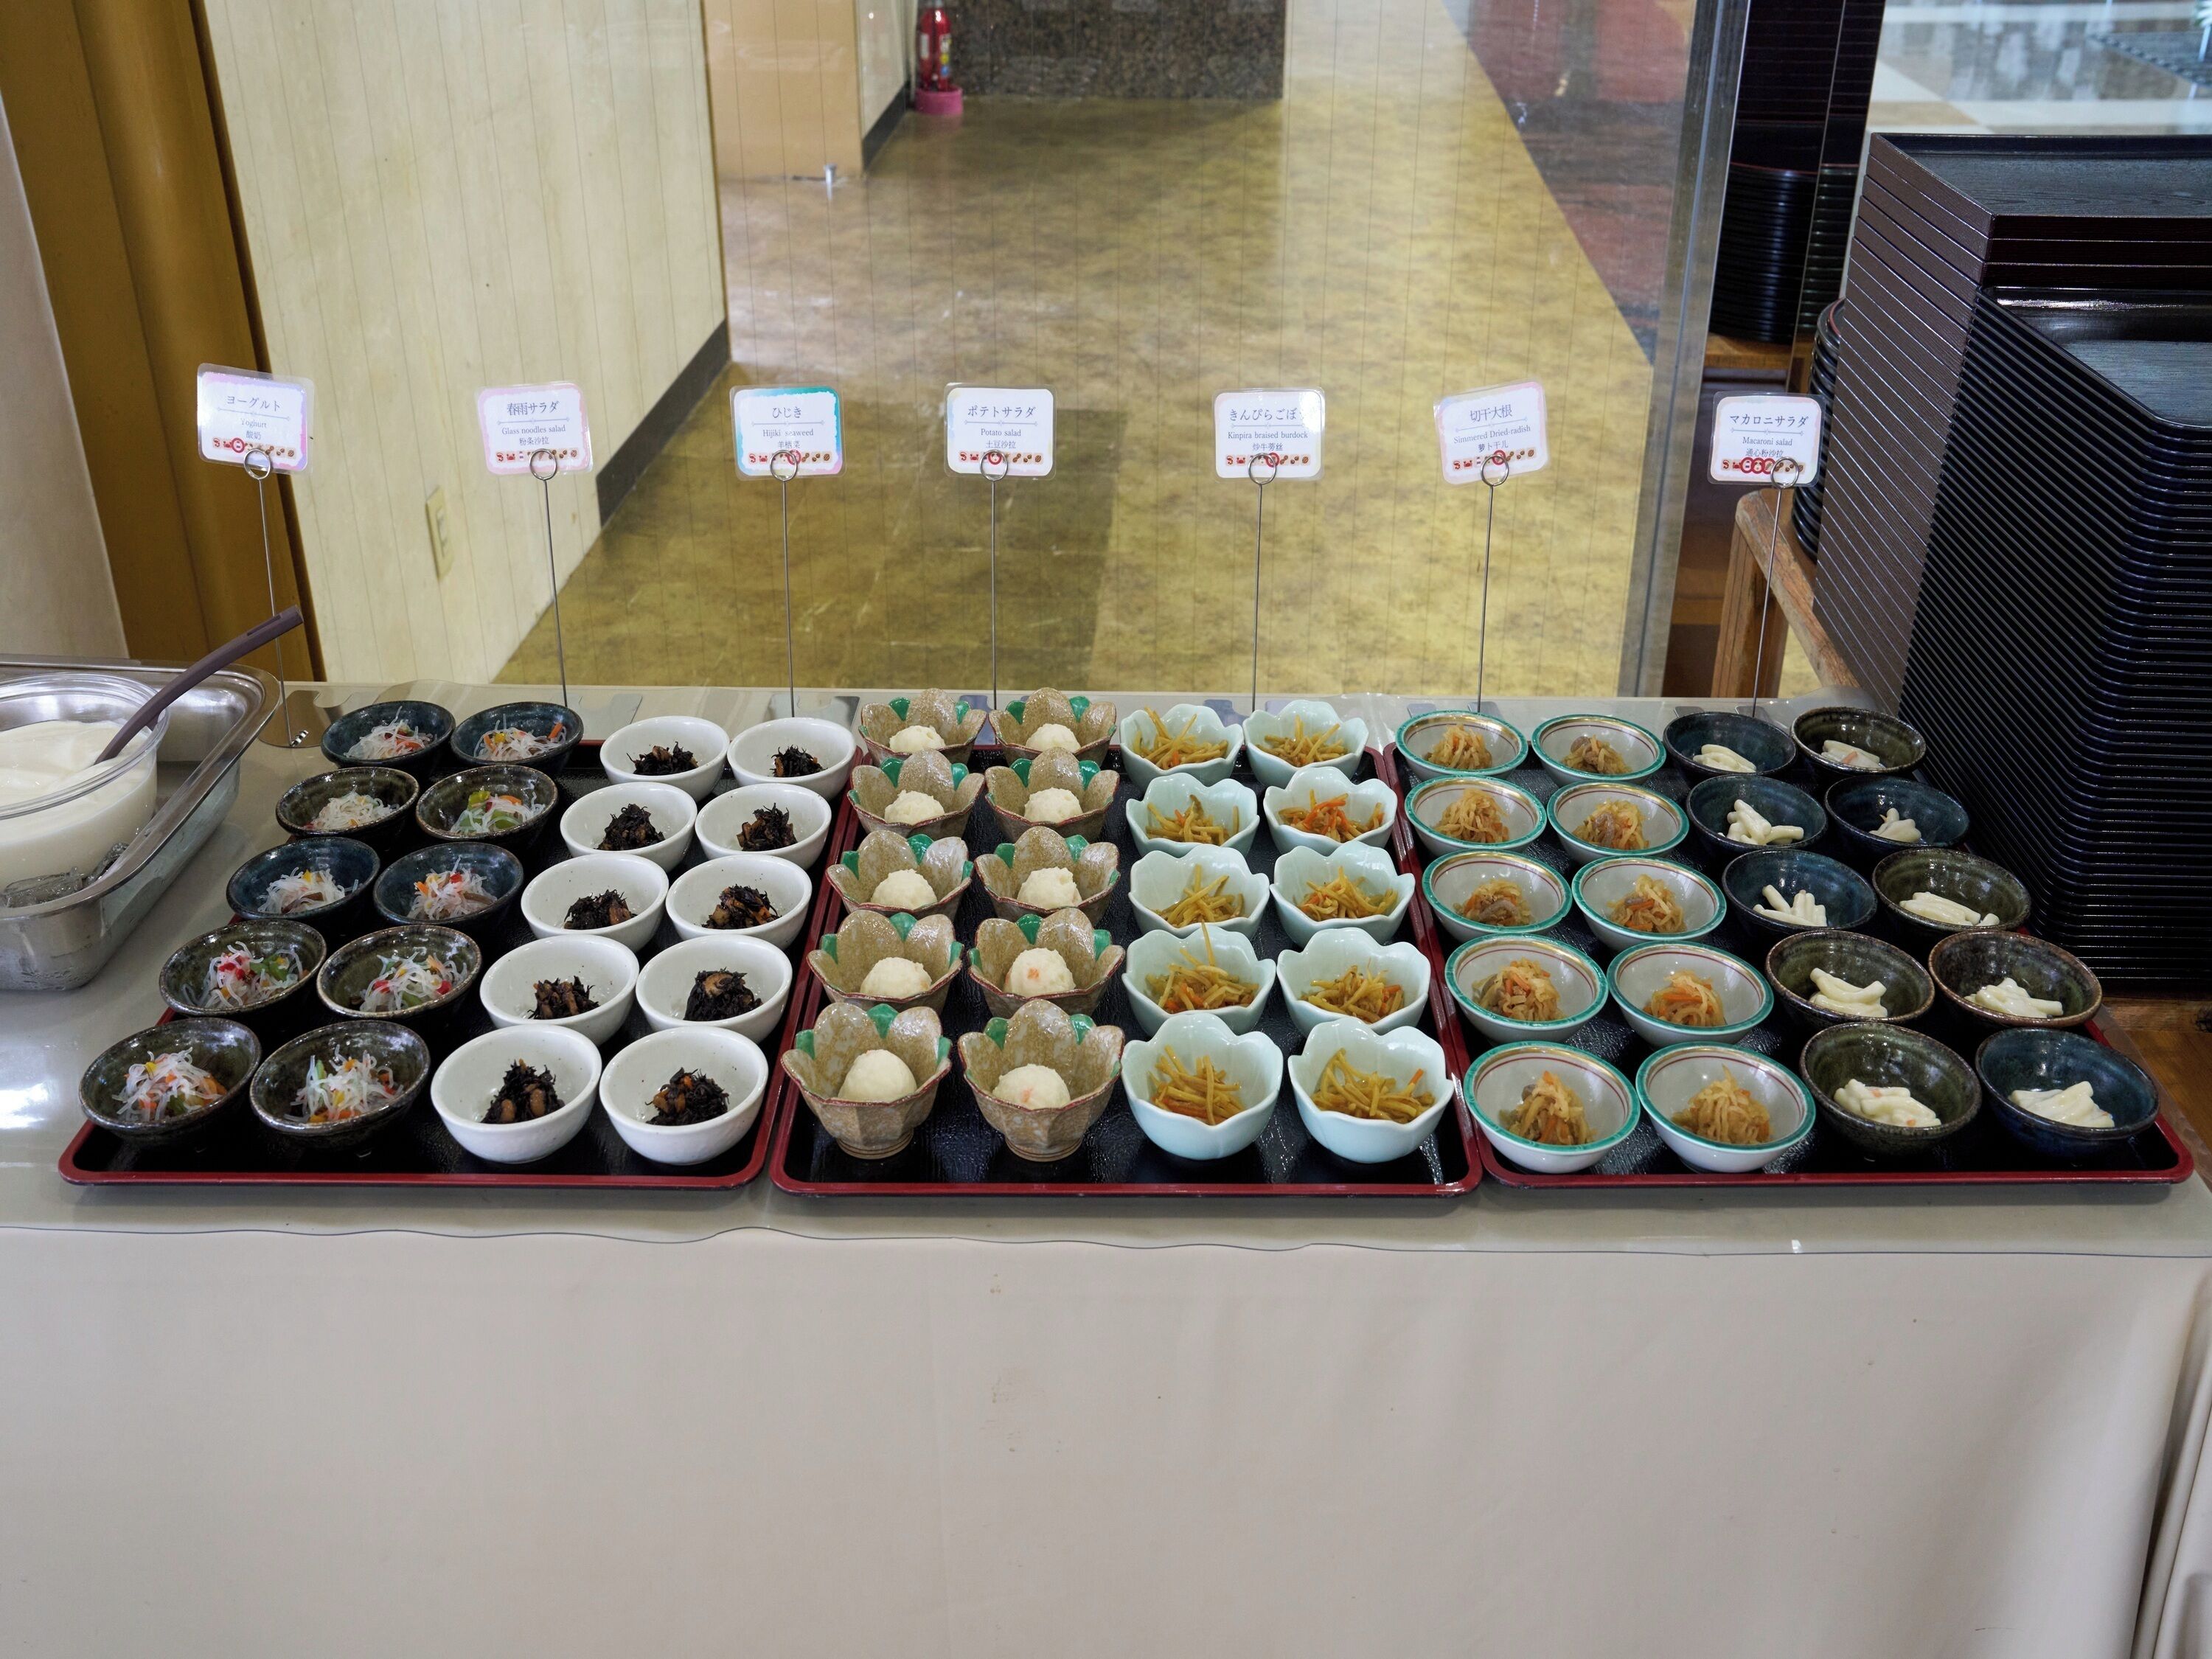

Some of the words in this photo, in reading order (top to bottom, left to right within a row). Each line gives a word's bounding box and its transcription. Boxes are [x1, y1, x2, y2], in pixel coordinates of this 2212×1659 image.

[227, 396, 280, 411] ヨーグルト
[507, 400, 560, 416] 春雨サラダ
[773, 406, 801, 418] ひじき
[967, 405, 1036, 417] ポテトサラダ
[1229, 408, 1304, 421] きんぴらごぼ
[240, 418, 266, 428] Yoghurt
[1730, 414, 1809, 428] マカロニサラダ
[763, 429, 781, 438] Hijiki
[1228, 431, 1252, 440] Kinpira
[1454, 431, 1488, 444] Simmered
[1742, 437, 1773, 445] Macaroni
[1775, 438, 1792, 446] salad
